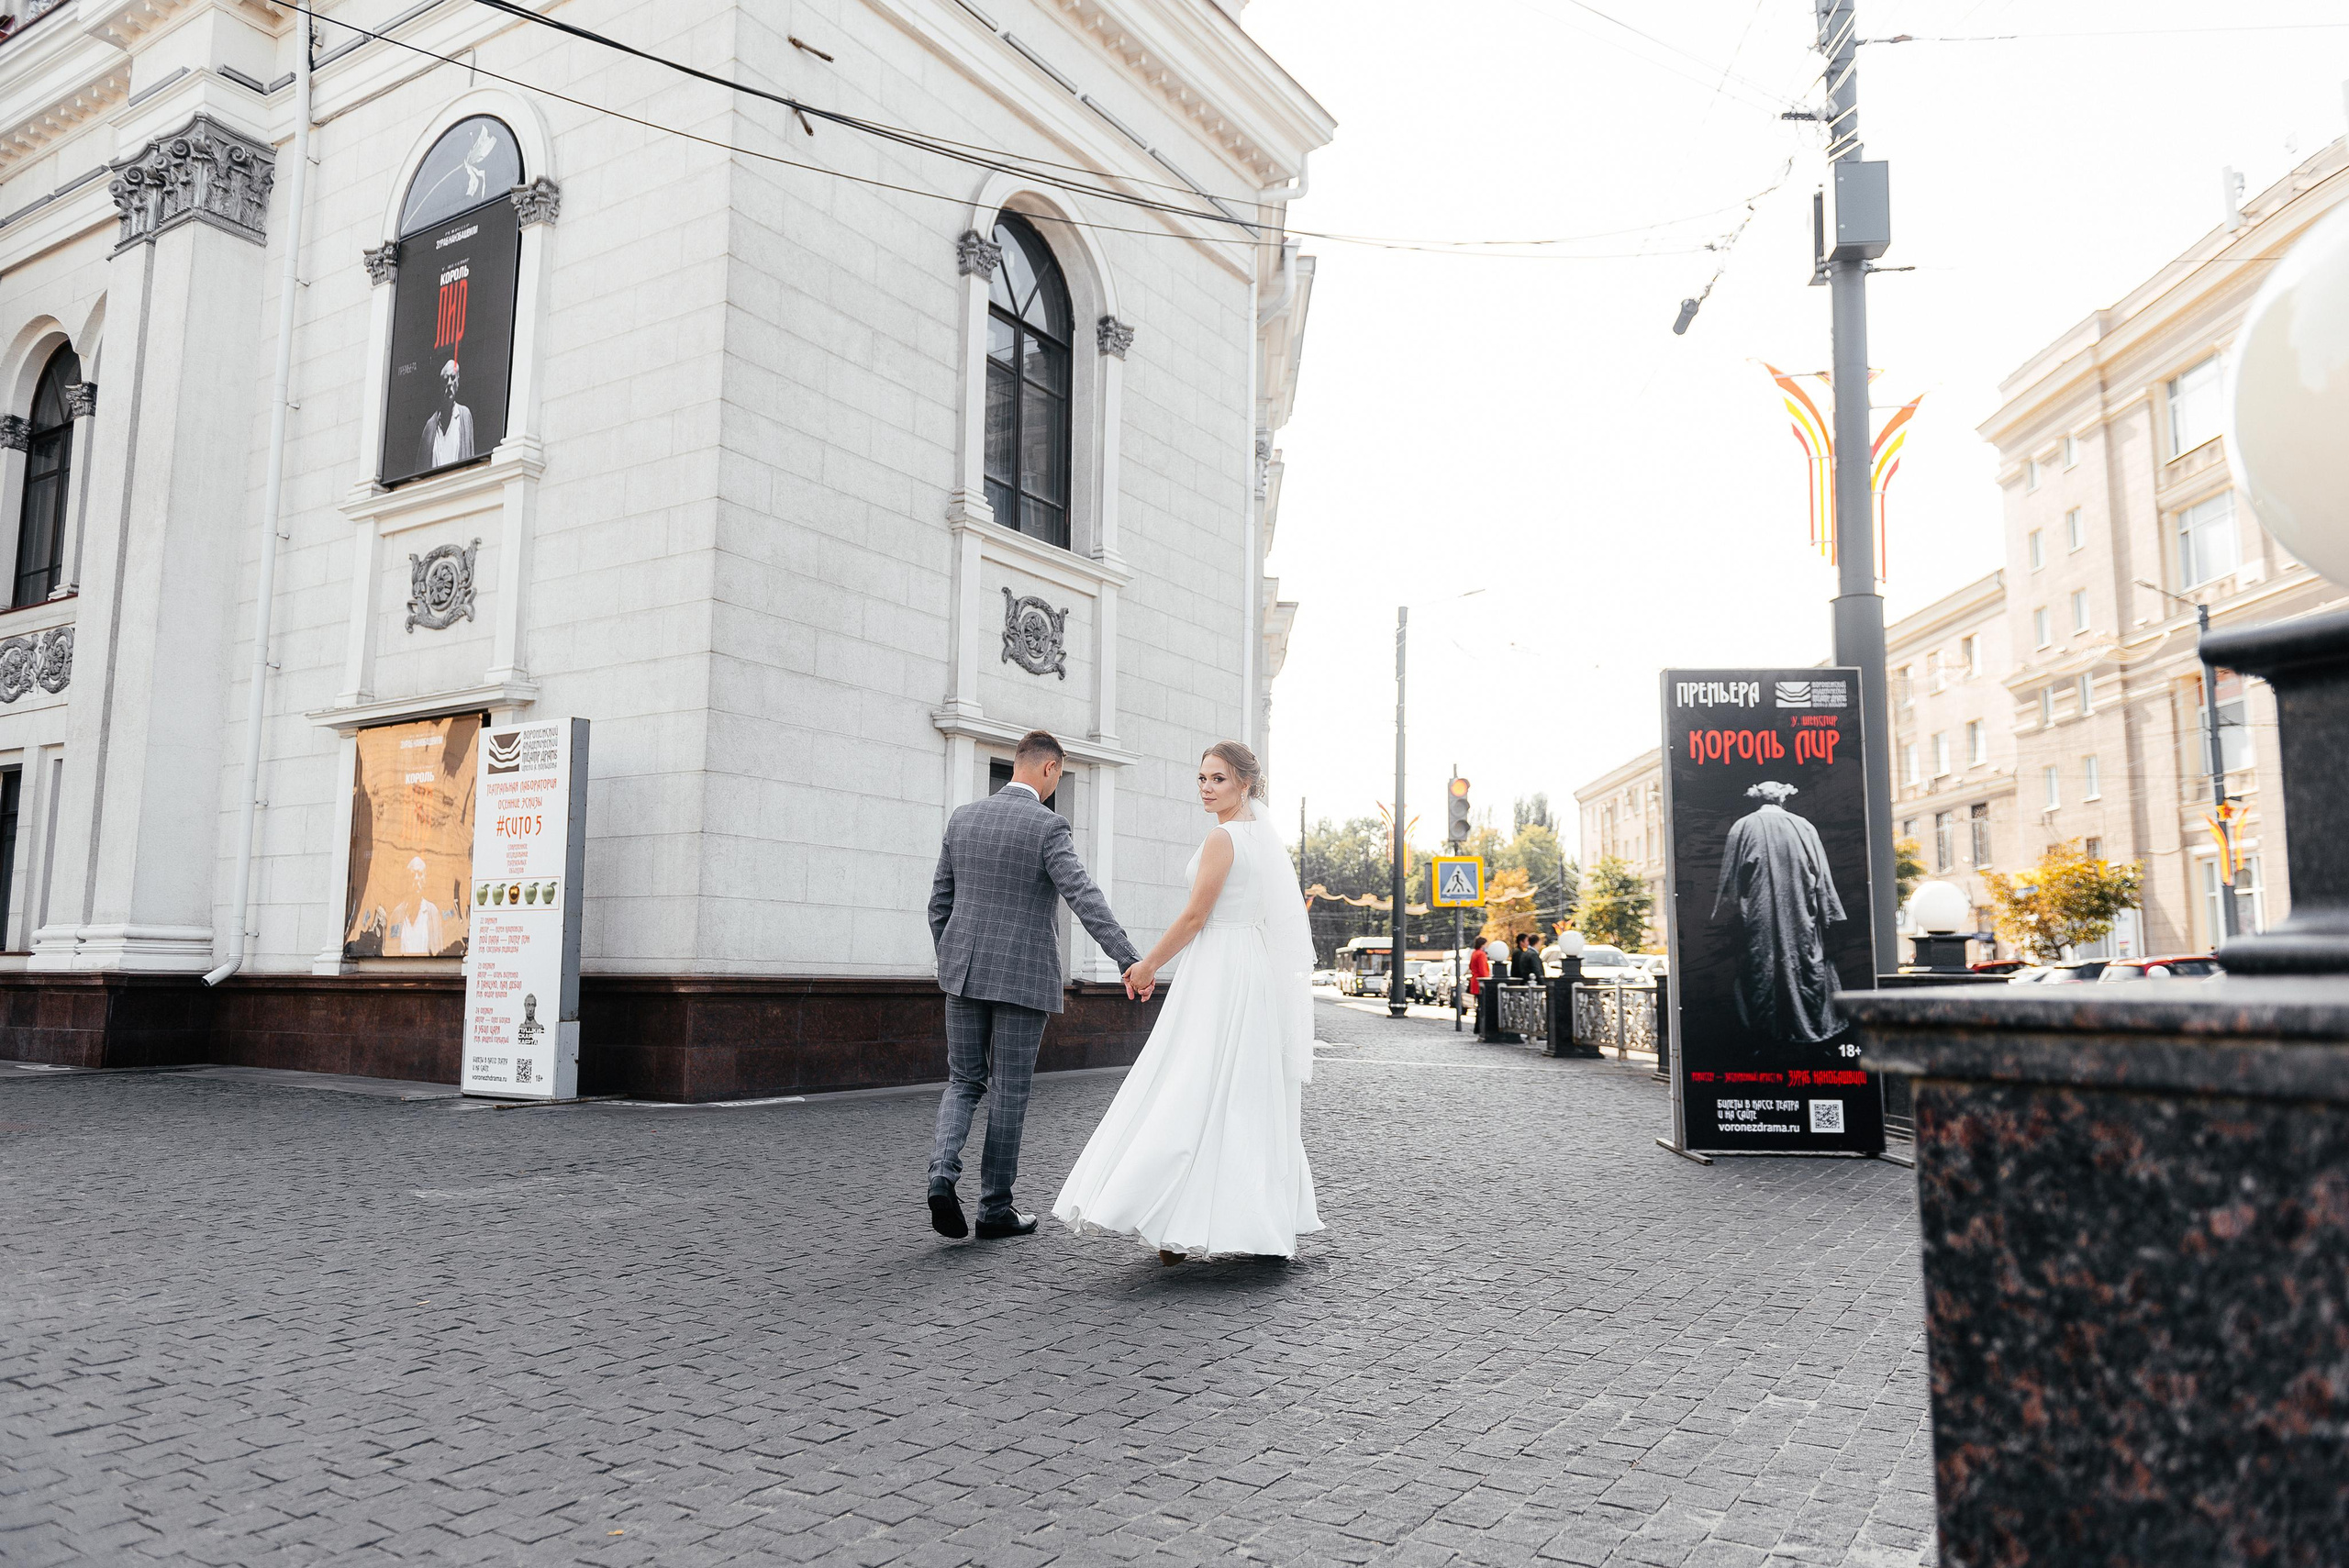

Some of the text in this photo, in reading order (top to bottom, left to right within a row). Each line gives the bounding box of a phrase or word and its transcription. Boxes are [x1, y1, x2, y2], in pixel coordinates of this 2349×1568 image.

[440, 265, 469, 286] КОРОЛЬ
[434, 279, 468, 352] ЛИР
[1676, 681, 1760, 708] ПРЕМЬЕРА
[1802, 715, 1838, 727] ШЕКСПИР
[1689, 730, 1840, 765] КОРОЛЬ ЛИР
[522, 751, 540, 764] ТЕАТР
[405, 771, 435, 785] КОРОЛЬ
[487, 778, 557, 796] ТЕАТРАЛЬНАЯ ЛАБОРАТОРИЯ
[498, 797, 542, 810] ОСЕННИЕ ЭСКИЗЫ
[496, 815, 542, 839] #СИТО 5
[1838, 1044, 1861, 1057] 18+
[1787, 1070, 1811, 1087] ЗУРАБ
[1813, 1070, 1868, 1087] НАНОБАШВИЛИ
[1717, 1099, 1799, 1111] БИЛЕТЫ В КАССЕ ТЕАТРА
[1717, 1109, 1757, 1121] И НА САЙТЕ
[1718, 1122, 1800, 1133] voronezdrama.ru
